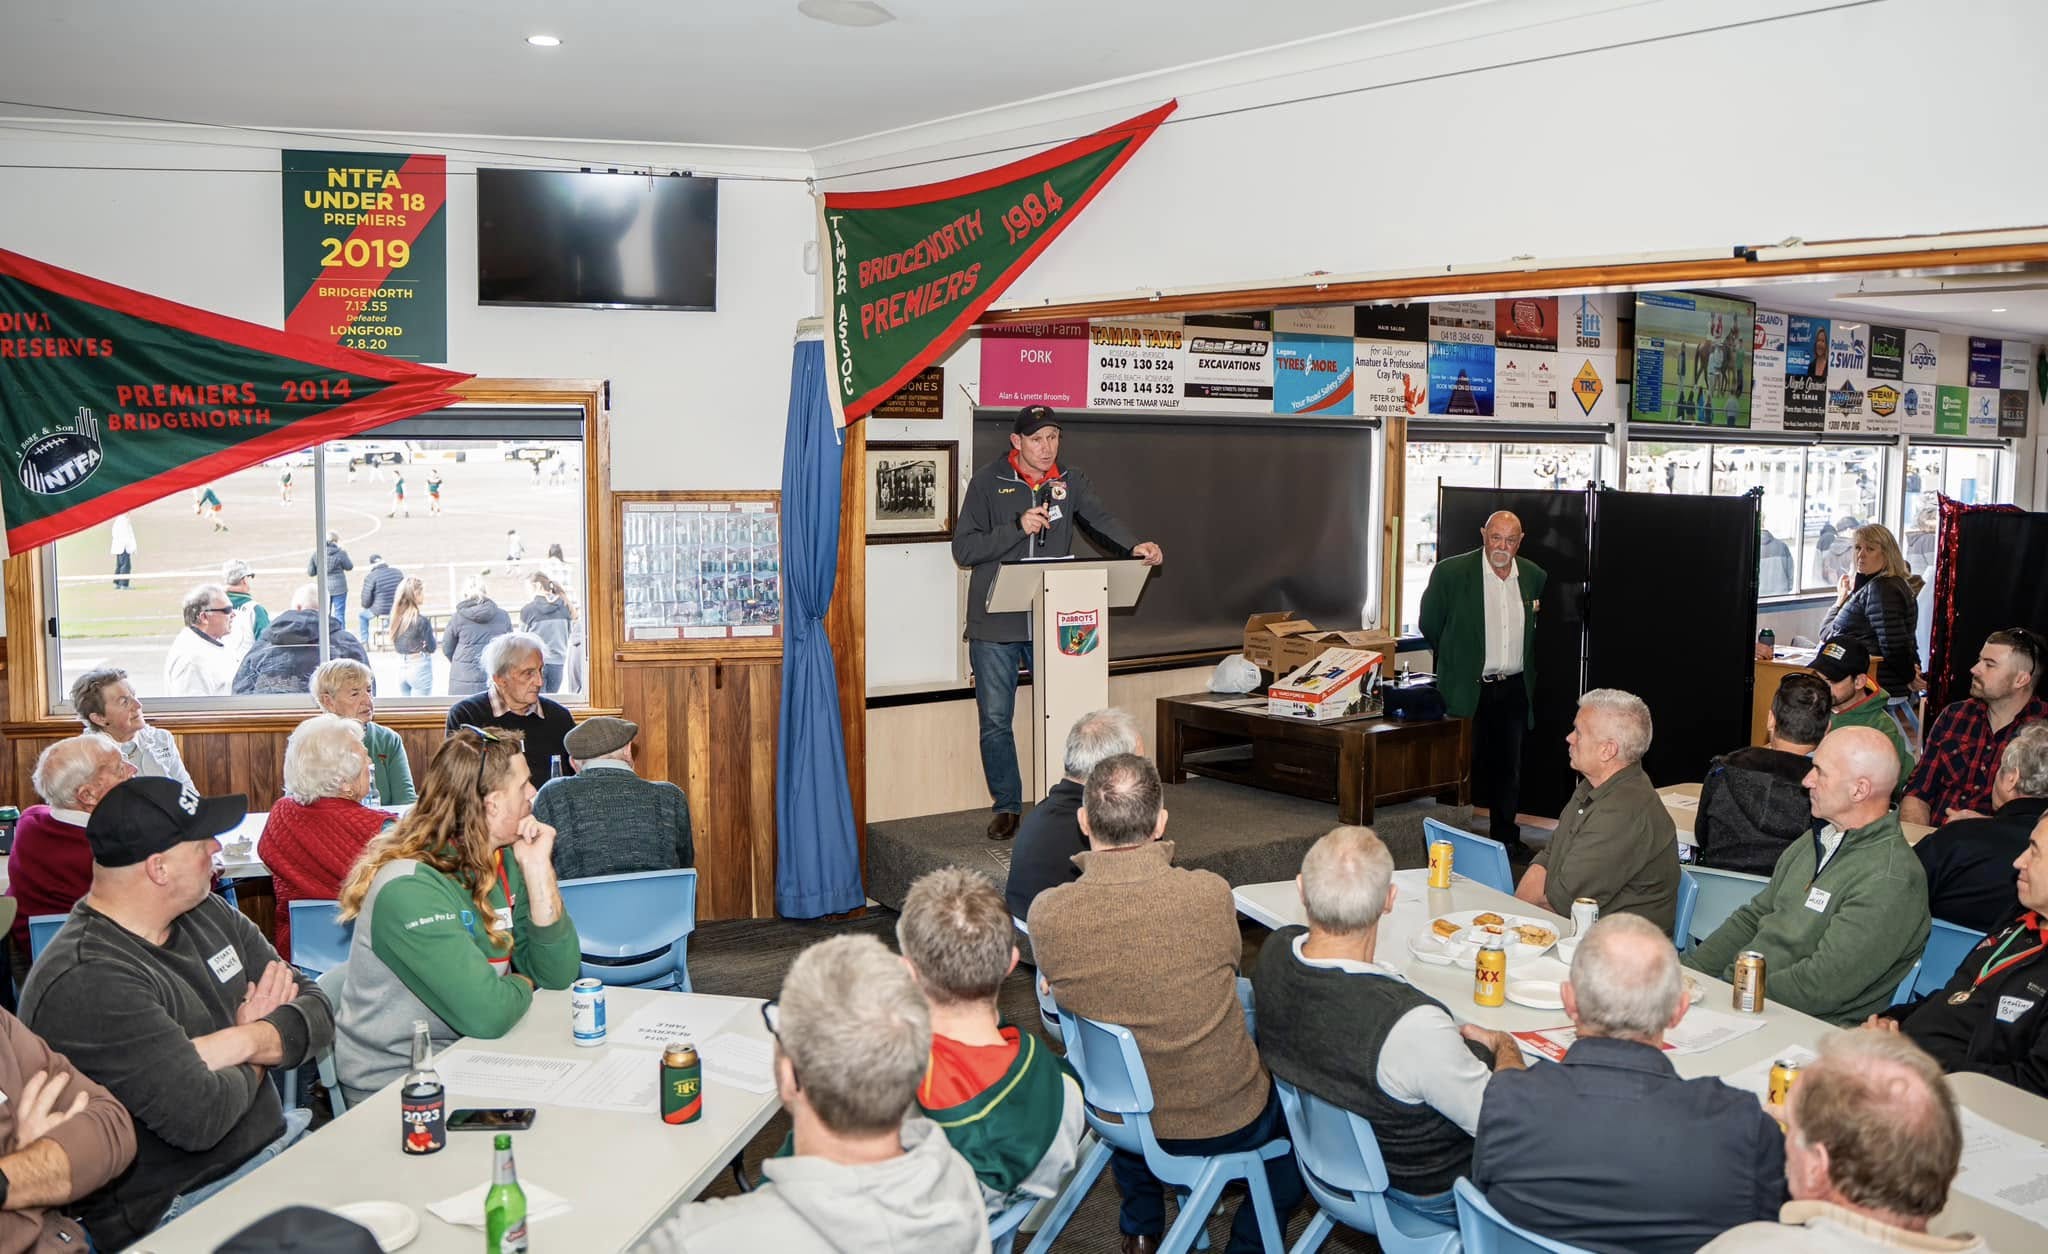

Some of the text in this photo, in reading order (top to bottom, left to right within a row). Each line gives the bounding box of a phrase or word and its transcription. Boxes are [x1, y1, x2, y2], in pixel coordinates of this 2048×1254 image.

[327, 167, 402, 190] NTFA
[304, 191, 426, 212] UNDER 18
[323, 213, 407, 227] PREMIERS
[858, 181, 1064, 289] BRIDGENORTH 1984
[320, 238, 411, 268] 2019
[318, 287, 413, 300] BRIDGENORTH
[344, 300, 388, 313] 7.13.55
[829, 215, 854, 396] TAMAR ASSOC
[861, 262, 982, 339] PREMIERS
[0, 312, 52, 332] DIV.1
[346, 314, 387, 323] Defeated
[330, 325, 403, 337] LONGFORD
[1053, 323, 1081, 337] Farm
[1440, 330, 1458, 340] 0418
[1459, 331, 1471, 341] 394
[346, 338, 387, 350] 2.8.20
[1091, 326, 1182, 350] TAMAR TAXIS
[1576, 336, 1600, 348] SHED
[1, 337, 113, 358] RESERVES
[1370, 345, 1411, 360] for all your
[1020, 349, 1052, 364] PORK
[1910, 354, 1937, 369] Legana
[1100, 357, 1174, 371] 0419 130 524
[1199, 359, 1261, 371] EXCAVATIONS
[1383, 358, 1388, 368] &
[1389, 358, 1426, 370] Professional
[1376, 369, 1405, 381] Cray Pots
[116, 378, 353, 408] PREMIERS 2014
[1100, 382, 1174, 394] 0418 144 532
[1580, 380, 1596, 393] TRC
[998, 392, 1013, 400] Alan
[1014, 392, 1019, 400] &
[1020, 392, 1042, 402] Lynette
[1370, 394, 1390, 403] PETER
[1867, 390, 1893, 400] STEAM
[1093, 397, 1180, 408] SERVING THE TAMAR VALLEY
[1291, 397, 1307, 409] Your
[108, 408, 272, 432] BRIDGENORTH
[55, 424, 74, 432] Son
[44, 448, 101, 489] NTFA
[1061, 614, 1093, 623] PARROTS
[404, 1109, 440, 1122] 2023
